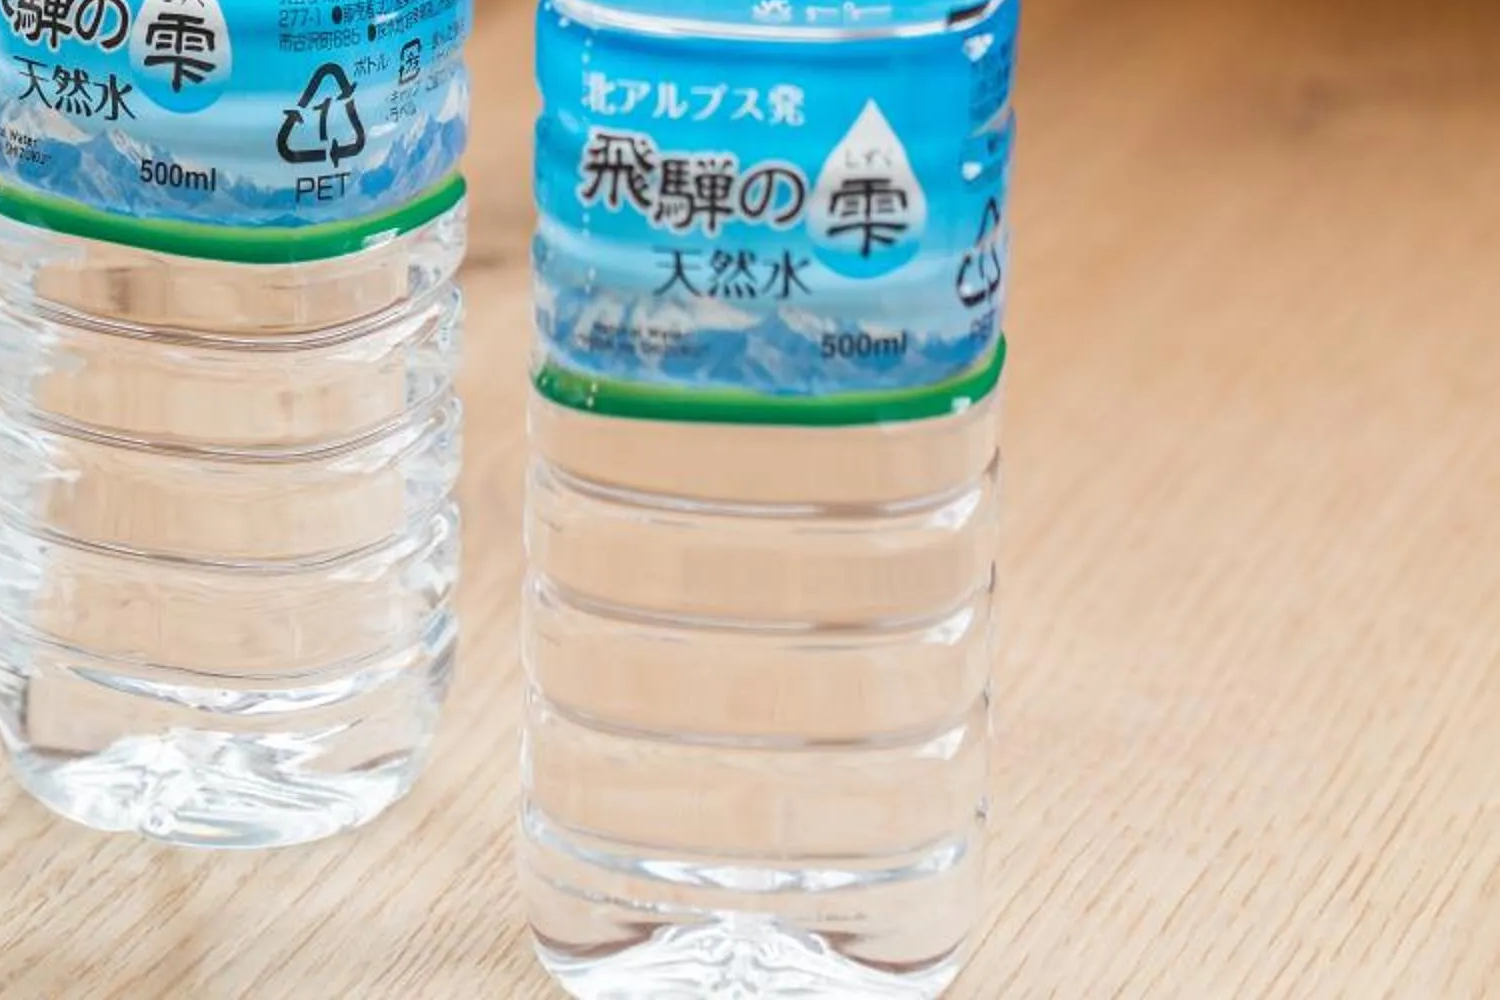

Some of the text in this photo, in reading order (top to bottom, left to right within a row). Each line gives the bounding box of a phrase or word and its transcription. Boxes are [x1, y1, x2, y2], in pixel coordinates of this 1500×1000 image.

[145, 13, 216, 92] 雫
[13, 55, 136, 121] 天然水
[582, 70, 806, 127] 北アルプス発
[140, 159, 217, 191] 500ml
[296, 172, 351, 203] PET
[827, 178, 909, 258] 雫
[653, 248, 815, 299] 天然水
[821, 333, 907, 359] 500ml
